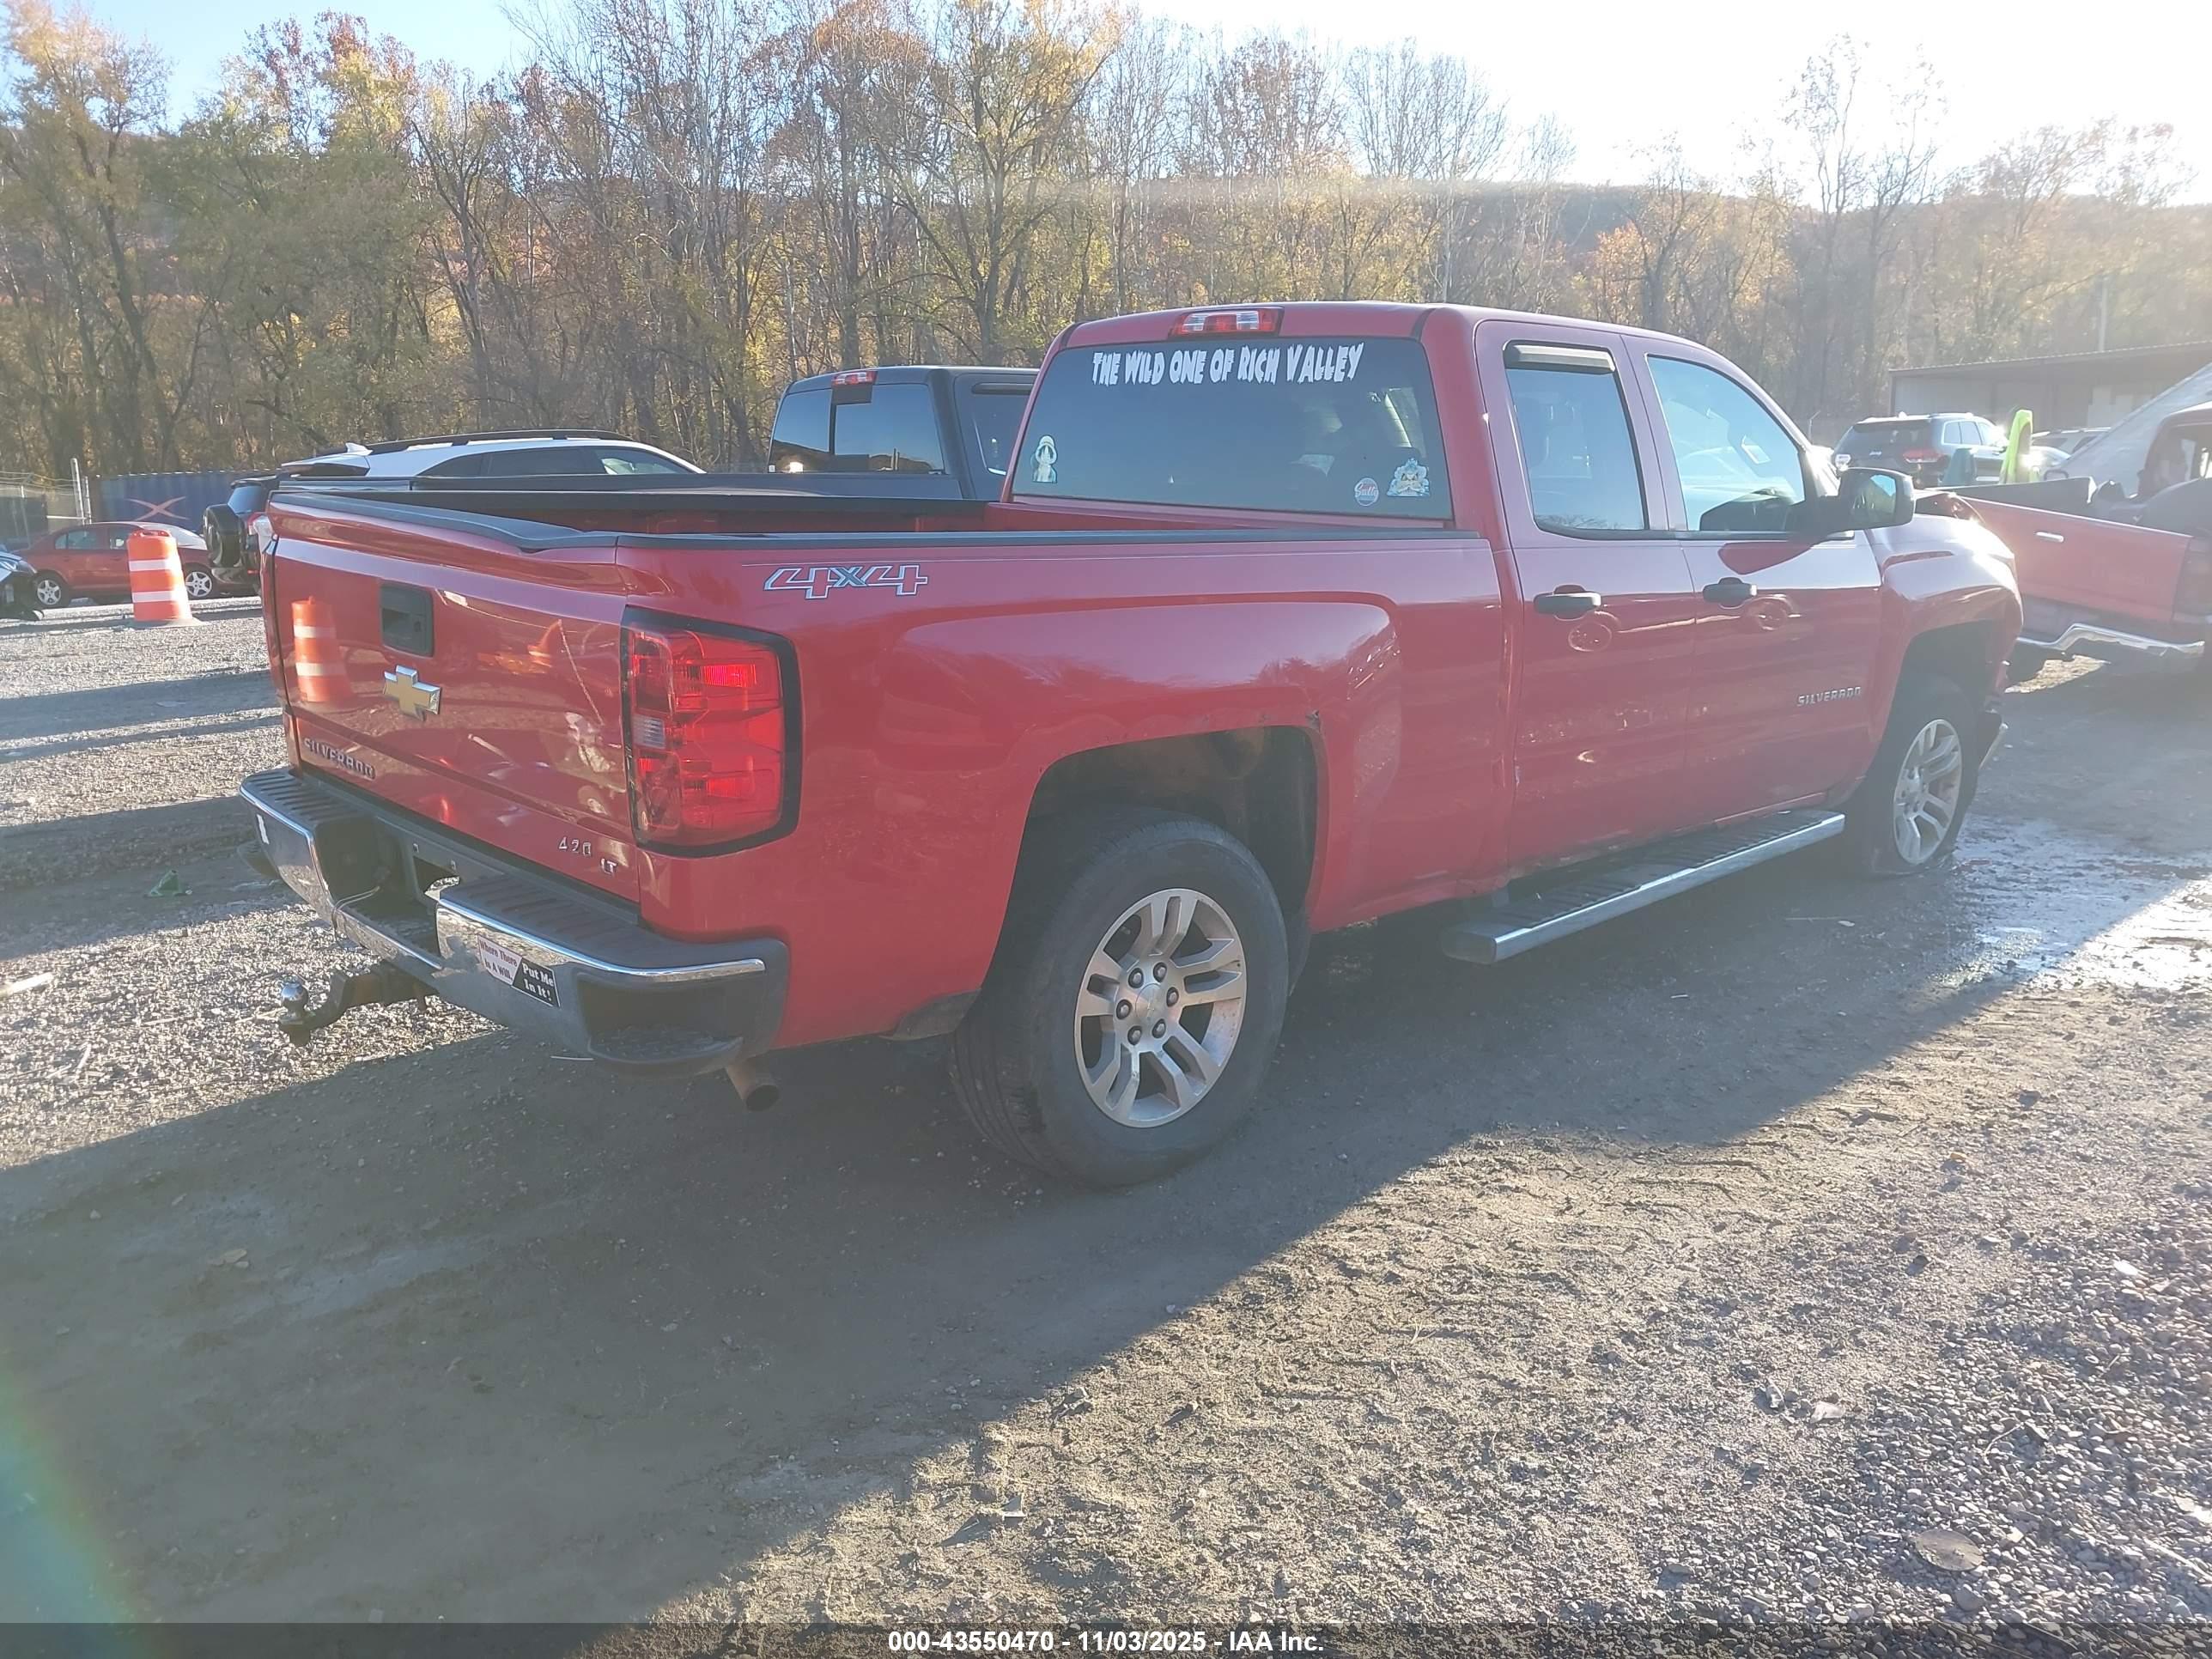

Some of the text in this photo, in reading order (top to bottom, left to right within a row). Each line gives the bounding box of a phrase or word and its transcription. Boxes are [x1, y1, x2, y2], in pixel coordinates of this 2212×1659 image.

[1092, 343, 1364, 386] THE WILD ONE OF RICH VALLEY
[1796, 686, 1862, 707] SILVERADO
[304, 738, 376, 781] SILVERADO
[601, 858, 617, 875] LT
[479, 939, 518, 968] Where There
[521, 962, 555, 988] Put Me
[523, 978, 537, 994] In
